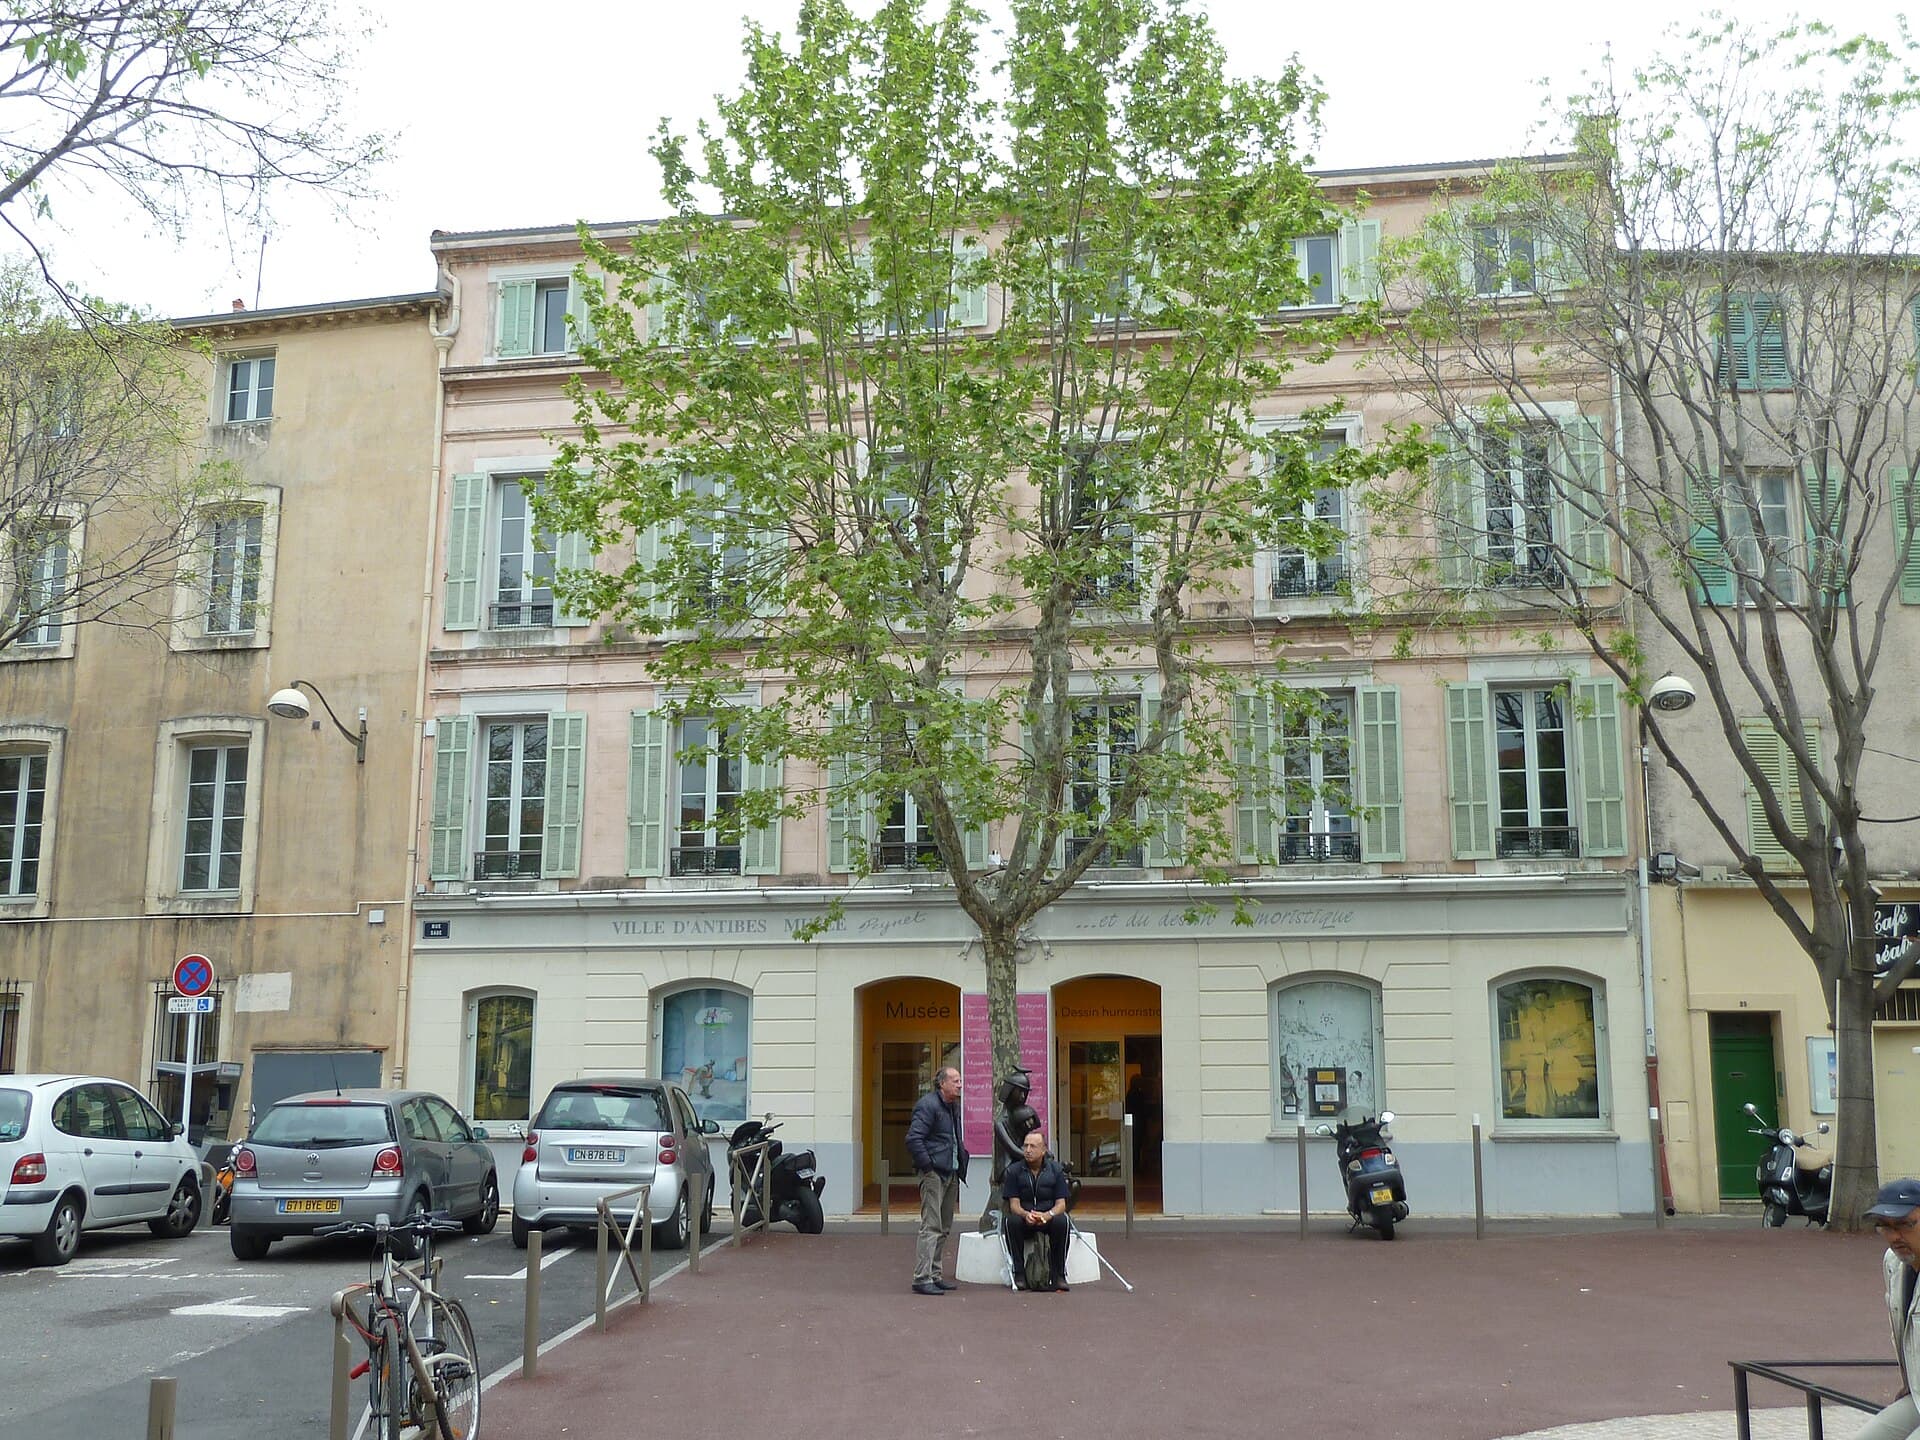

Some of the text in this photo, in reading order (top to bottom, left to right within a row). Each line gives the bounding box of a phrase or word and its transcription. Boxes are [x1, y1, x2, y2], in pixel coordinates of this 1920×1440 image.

[612, 921, 665, 935] VILLE
[673, 919, 767, 934] D'ANTIBES
[784, 917, 847, 933] MUE
[1126, 909, 1150, 927] du
[1158, 908, 1213, 927] desn
[1231, 908, 1354, 930] moristique
[885, 1000, 951, 1019] Musée
[587, 1150, 604, 1160] 878
[287, 1200, 337, 1210] 671 BYE 06
